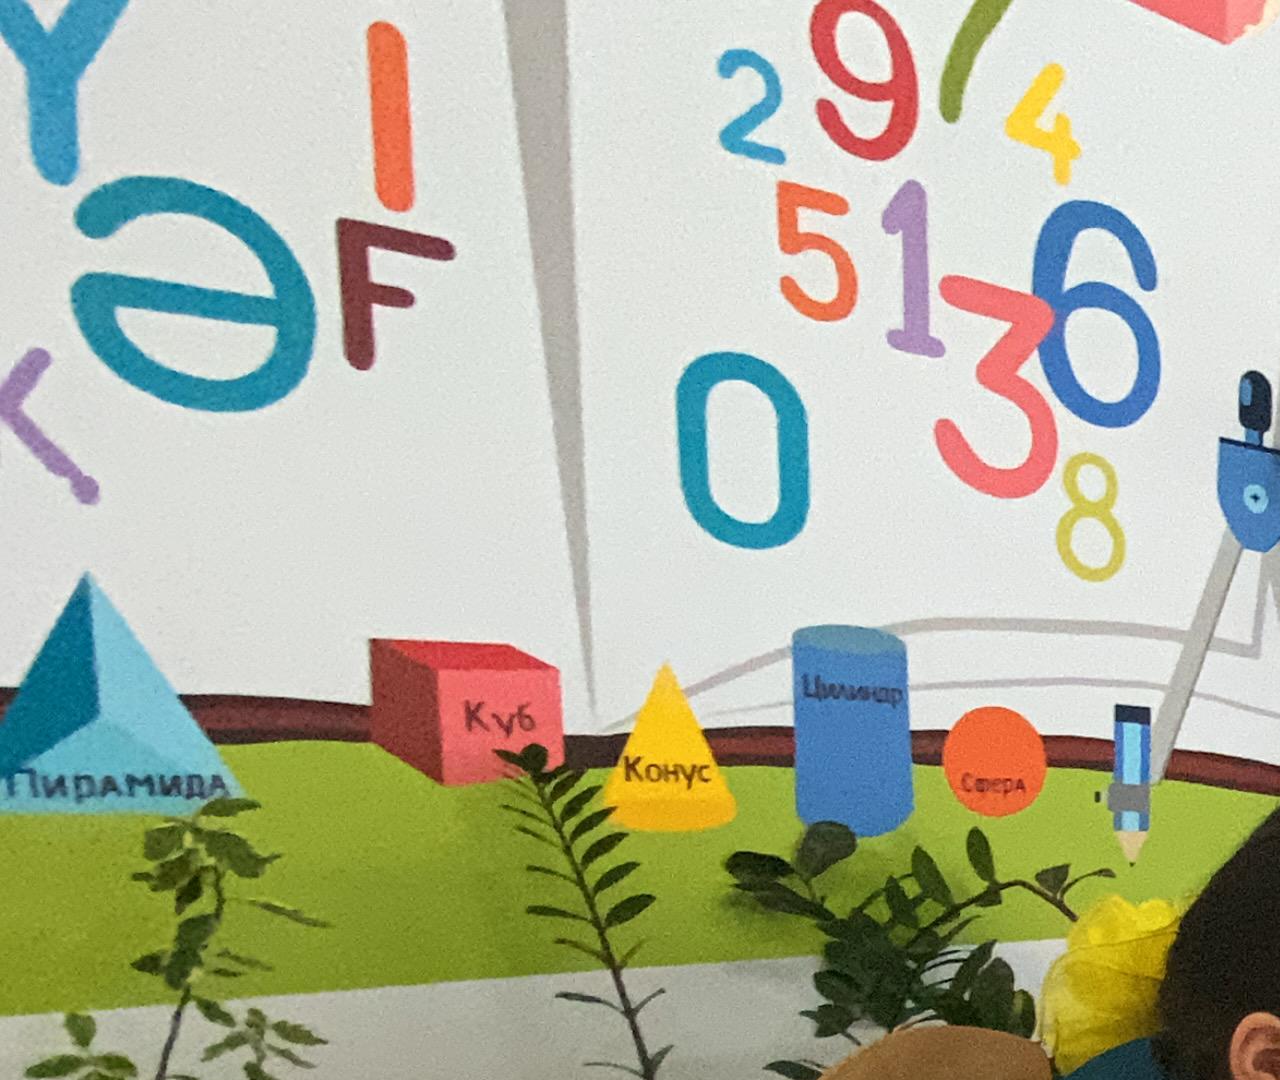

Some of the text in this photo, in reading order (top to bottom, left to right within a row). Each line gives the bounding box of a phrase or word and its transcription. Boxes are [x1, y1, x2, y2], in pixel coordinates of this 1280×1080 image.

[716, 48, 787, 165] 2
[810, 0, 920, 161] 9
[1004, 63, 1082, 185] 4
[775, 180, 858, 323] 5
[881, 179, 946, 358] 1
[1031, 200, 1162, 429] 6
[675, 350, 811, 550] 0
[933, 273, 1059, 500] 3
[1056, 451, 1127, 583] 8
[463, 699, 537, 738] Куб
[622, 755, 712, 789] Конус
